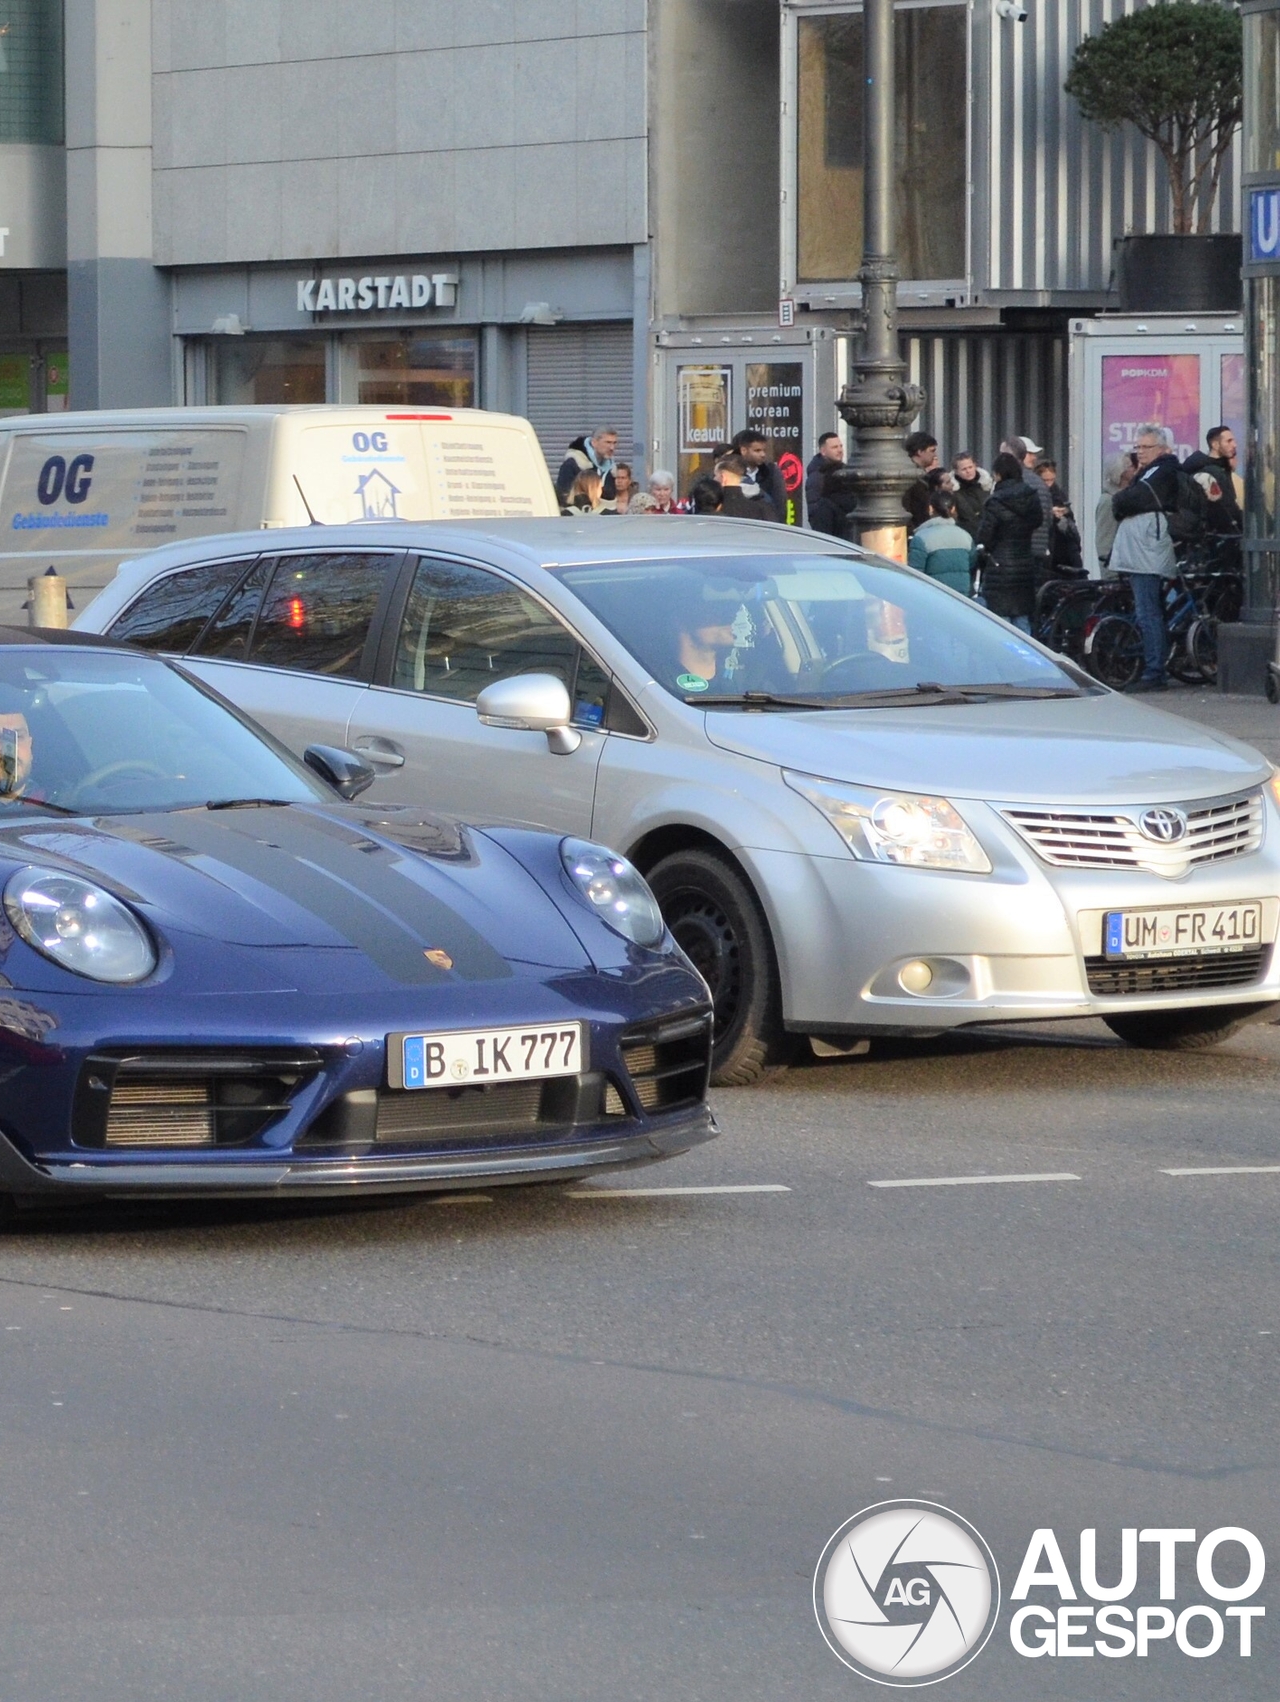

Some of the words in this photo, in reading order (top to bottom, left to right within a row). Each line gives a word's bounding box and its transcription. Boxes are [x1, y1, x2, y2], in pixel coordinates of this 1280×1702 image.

[1257, 195, 1278, 253] U
[297, 273, 450, 311] KARSTADT
[748, 383, 801, 398] premium
[748, 404, 790, 417] korean
[353, 431, 388, 453] OG
[37, 453, 95, 506] OG
[1111, 938, 1119, 947] D
[1125, 916, 1157, 947] UM
[1175, 913, 1206, 944] FR
[1211, 909, 1255, 941] 410
[426, 1042, 446, 1079] B
[473, 1036, 512, 1075] IK
[521, 1030, 576, 1071] 777
[411, 1067, 419, 1079] D
